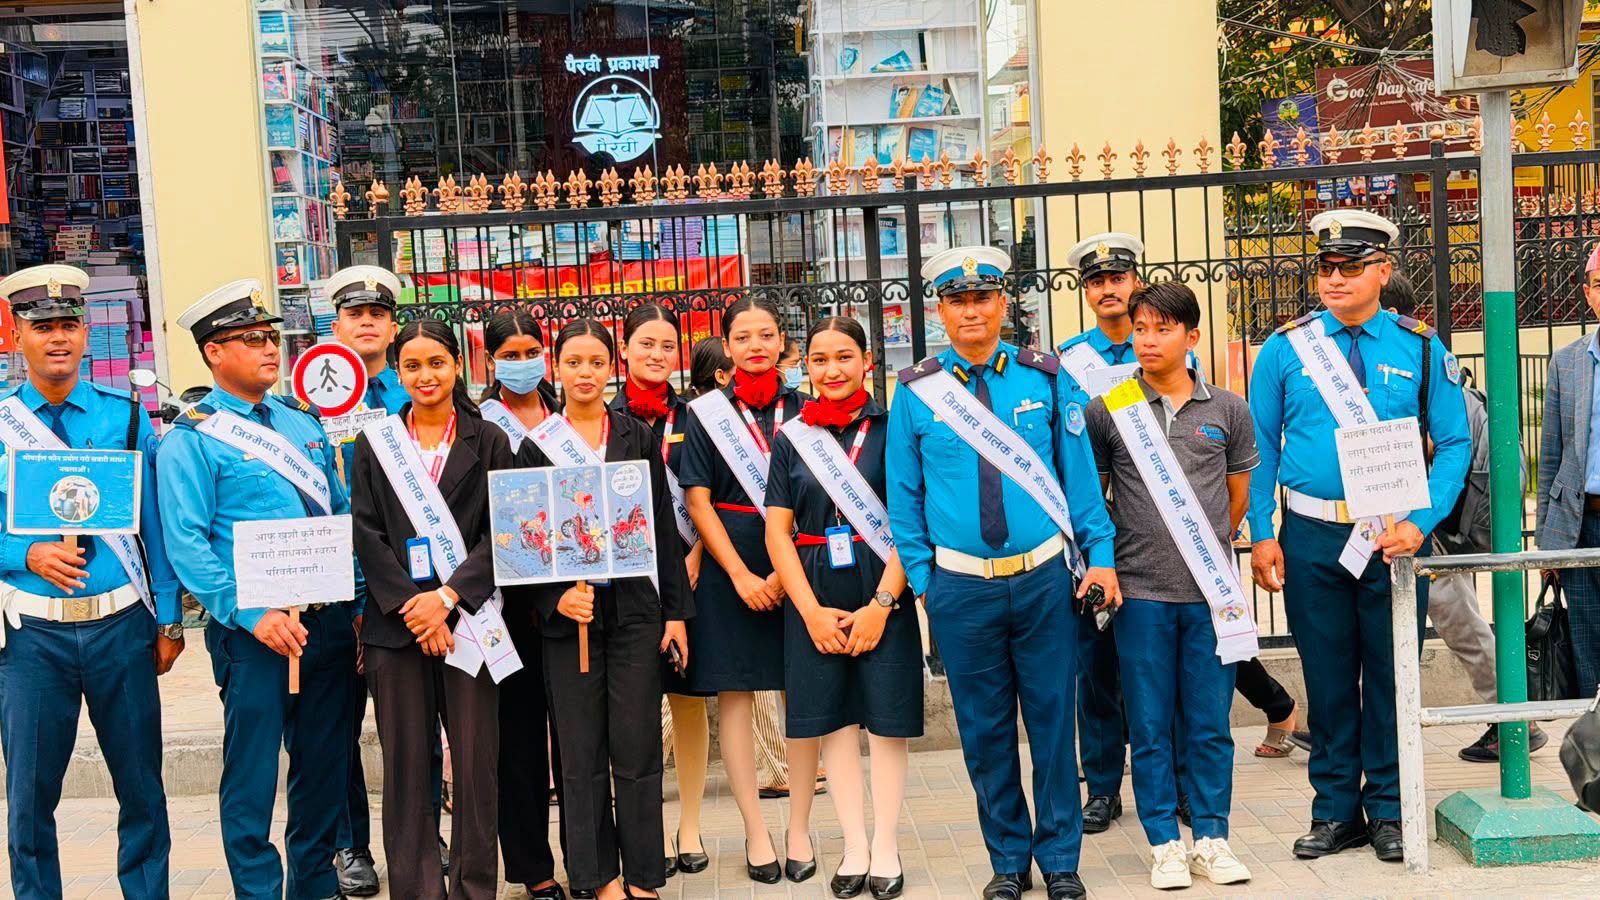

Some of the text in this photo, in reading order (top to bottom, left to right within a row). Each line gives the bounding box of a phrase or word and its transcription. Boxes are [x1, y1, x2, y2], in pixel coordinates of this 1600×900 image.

[565, 53, 660, 76] पैरवी प्रकाशन
[1327, 77, 1374, 102] Goo
[1375, 81, 1406, 98] Day
[1312, 341, 1336, 373] चालक
[718, 418, 749, 462] जिम्मेवार
[942, 390, 981, 430] जिम्मेवार
[982, 427, 1014, 456] चालक
[1343, 429, 1368, 439] मादक
[231, 424, 281, 456] जिम्मेवार
[283, 453, 310, 480] चालक
[381, 425, 407, 469] जिम्मेवार
[403, 467, 428, 501] चालक
[1125, 404, 1154, 450] जिम्मेवार
[1149, 450, 1173, 485] चालक
[810, 439, 842, 480] जिम्मेवार
[841, 479, 868, 511] चालक
[1366, 462, 1392, 474] सवारी
[249, 549, 276, 560] सवारी
